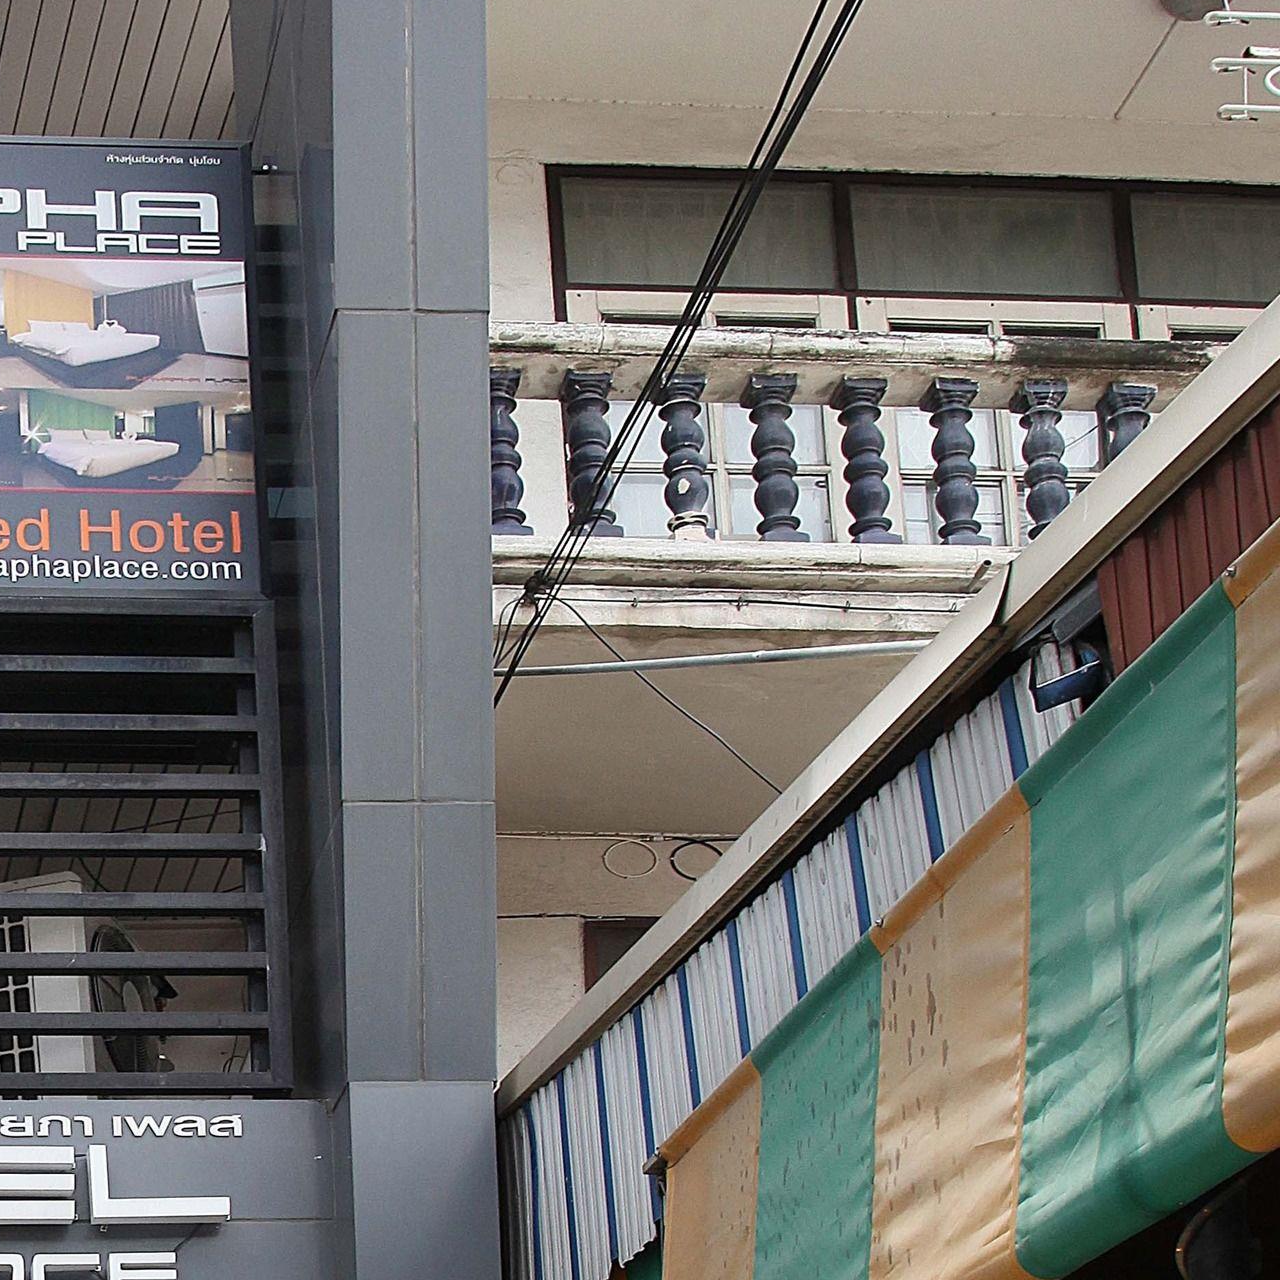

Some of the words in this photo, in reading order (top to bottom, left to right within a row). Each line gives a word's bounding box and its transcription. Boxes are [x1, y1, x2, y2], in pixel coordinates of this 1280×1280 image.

[17, 231, 221, 255] PLACE
[79, 509, 243, 555] Hotel
[112, 1113, 244, 1138] เพลส
